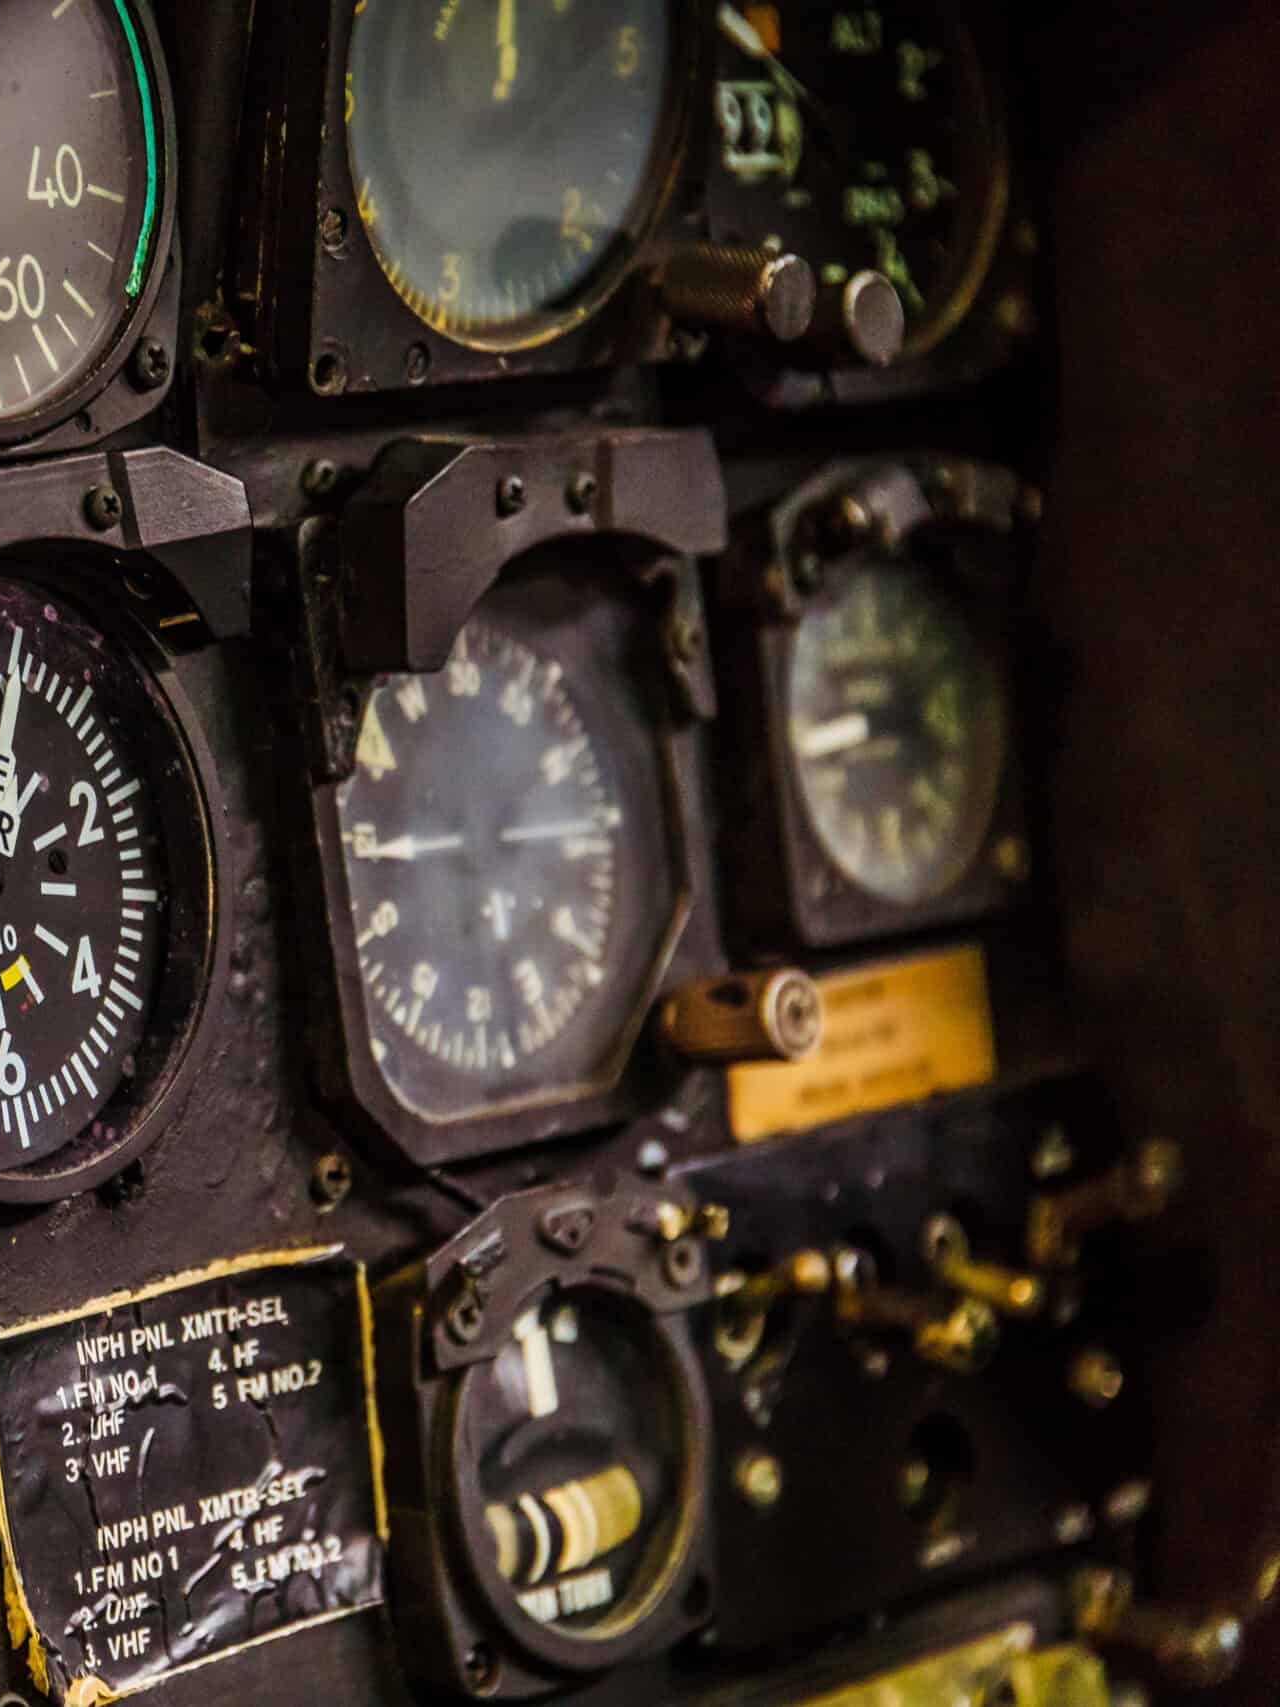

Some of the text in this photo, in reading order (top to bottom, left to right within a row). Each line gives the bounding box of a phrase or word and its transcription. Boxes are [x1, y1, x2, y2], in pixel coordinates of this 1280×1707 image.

[27, 144, 83, 207] 40
[69, 781, 104, 848] 2
[72, 935, 102, 998] 4
[77, 1332, 125, 1366] INPH
[131, 1322, 175, 1354] PNL
[233, 1339, 259, 1368] HF
[237, 1373, 269, 1402] FM
[90, 1409, 125, 1441] UHF
[92, 1446, 131, 1479] VHF
[97, 1516, 148, 1552] INPH
[152, 1506, 194, 1538] PNL
[254, 1515, 284, 1547] HF
[105, 1592, 149, 1626] UHF
[107, 1627, 151, 1661] VHF
